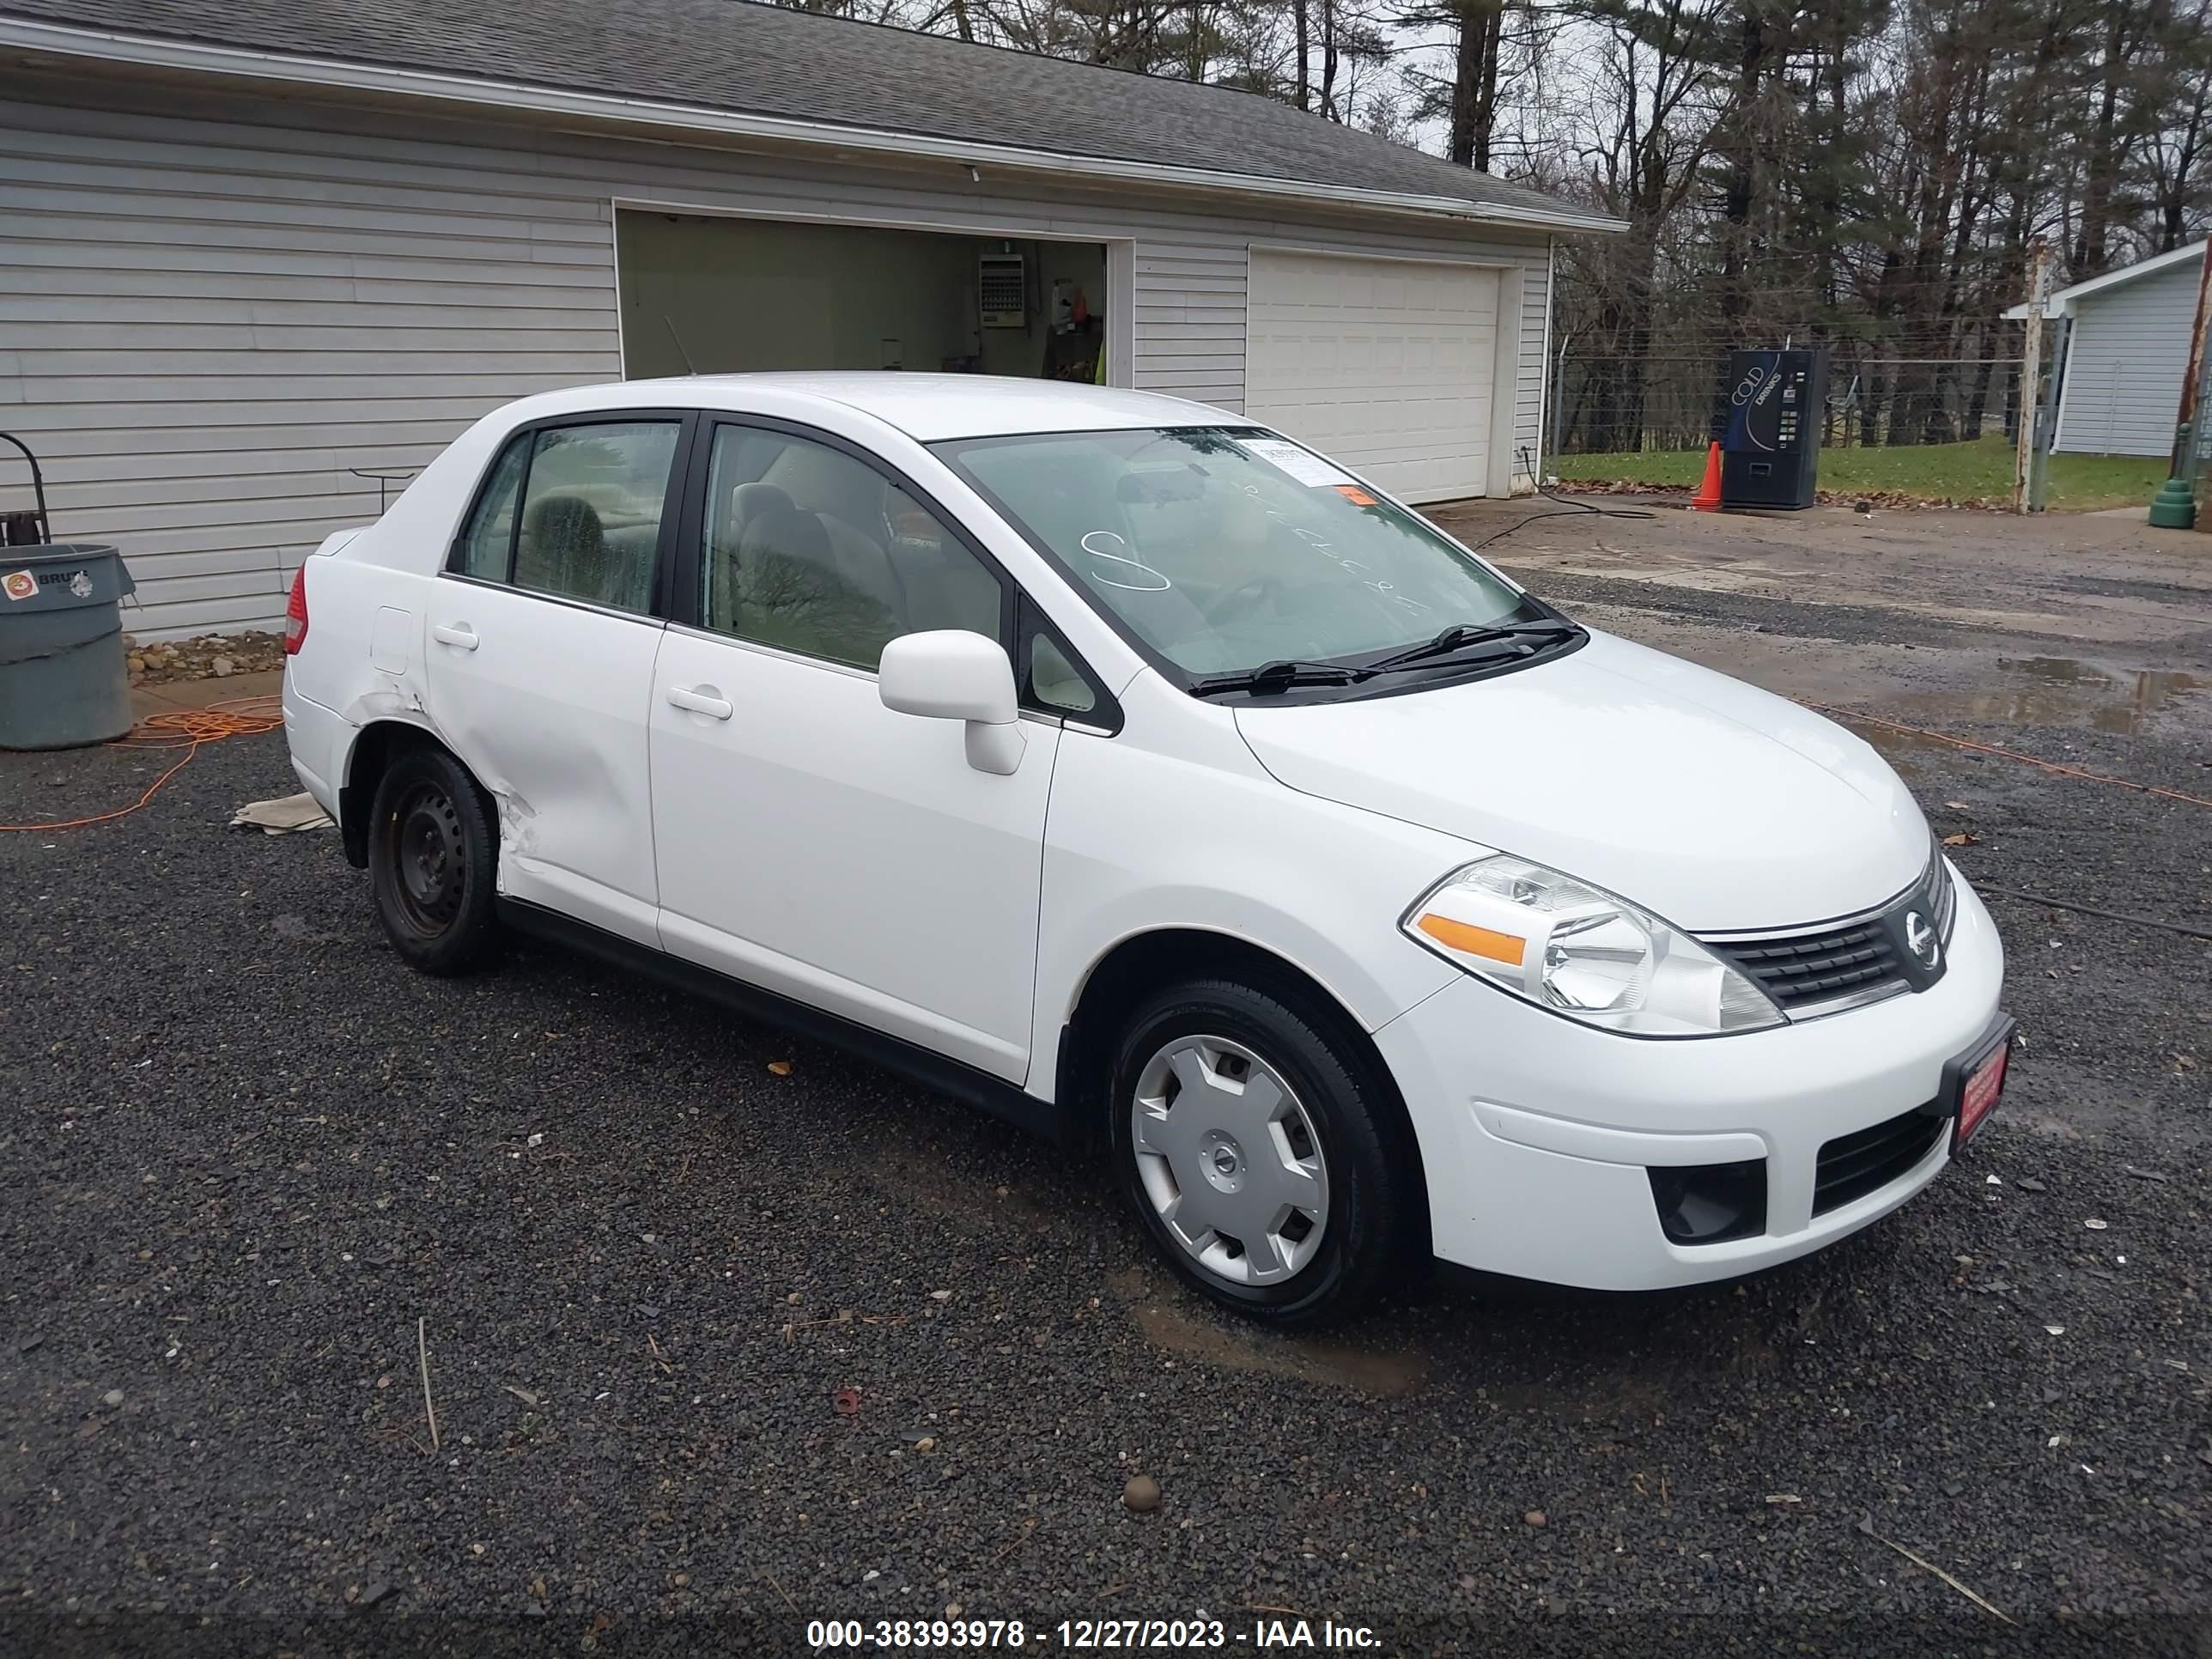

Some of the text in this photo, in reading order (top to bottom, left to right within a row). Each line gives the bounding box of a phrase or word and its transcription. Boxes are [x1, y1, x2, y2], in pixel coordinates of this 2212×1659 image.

[1731, 367, 1764, 406] COLD
[1754, 372, 1782, 406] DRINKS
[1080, 531, 1171, 592] S
